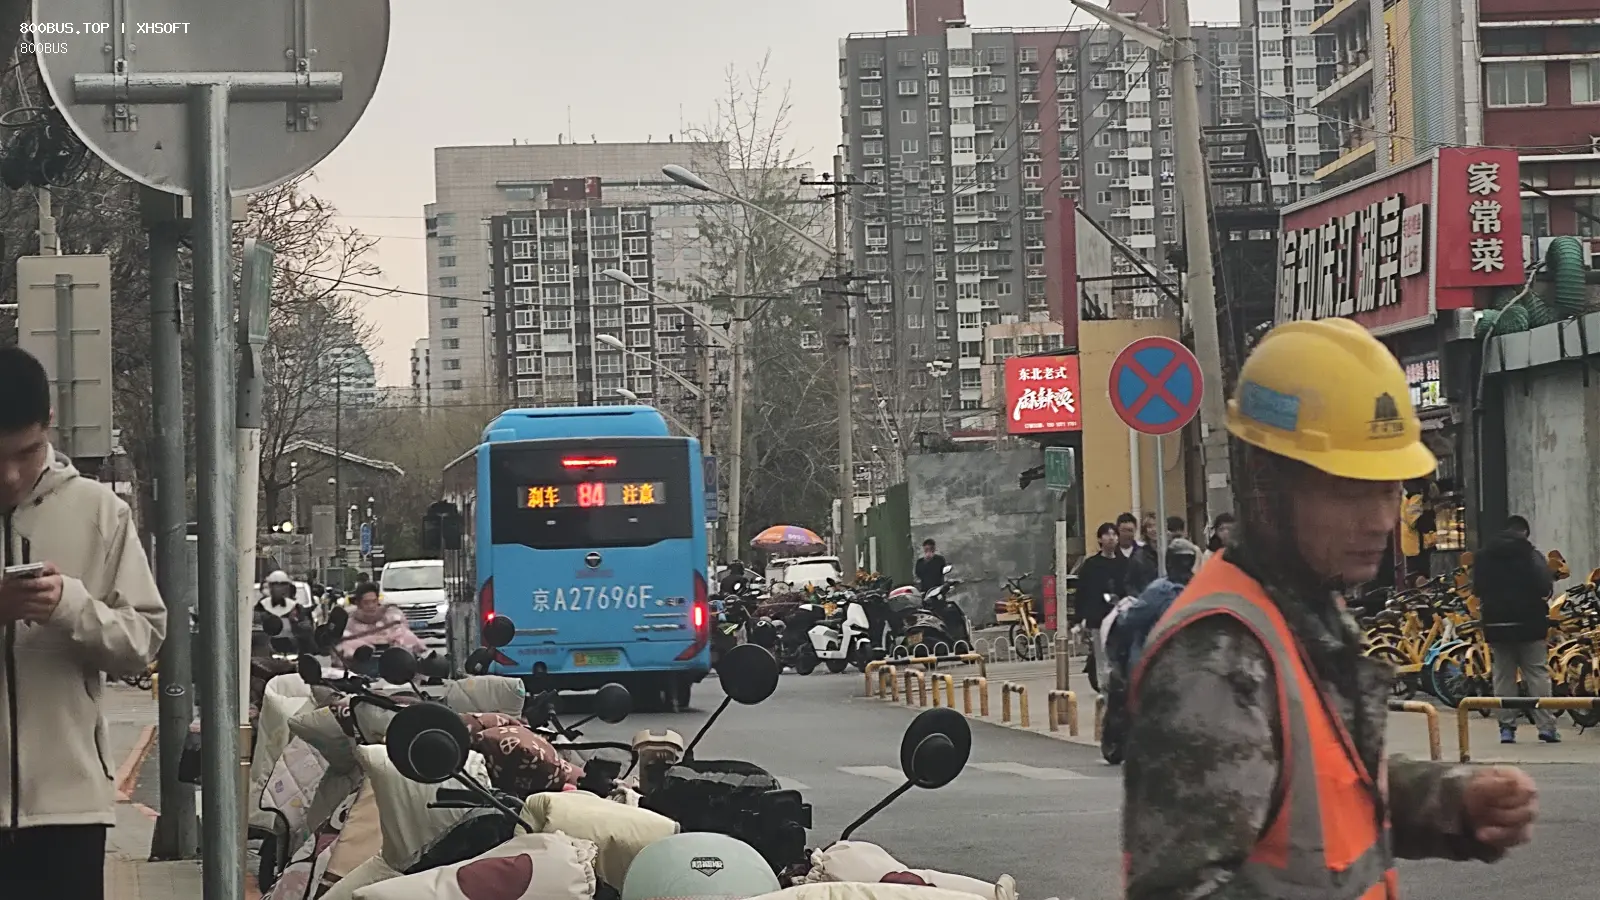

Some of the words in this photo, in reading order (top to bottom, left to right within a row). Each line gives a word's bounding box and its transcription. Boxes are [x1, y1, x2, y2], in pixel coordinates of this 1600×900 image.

[1466, 161, 1505, 274] 家常菜
[1018, 366, 1068, 381] 东北老式
[1012, 386, 1076, 421] 麻辣烫
[527, 486, 561, 508] 刹车
[577, 482, 606, 507] 84
[622, 483, 656, 506] 注意
[531, 584, 654, 612] 京A27696F
